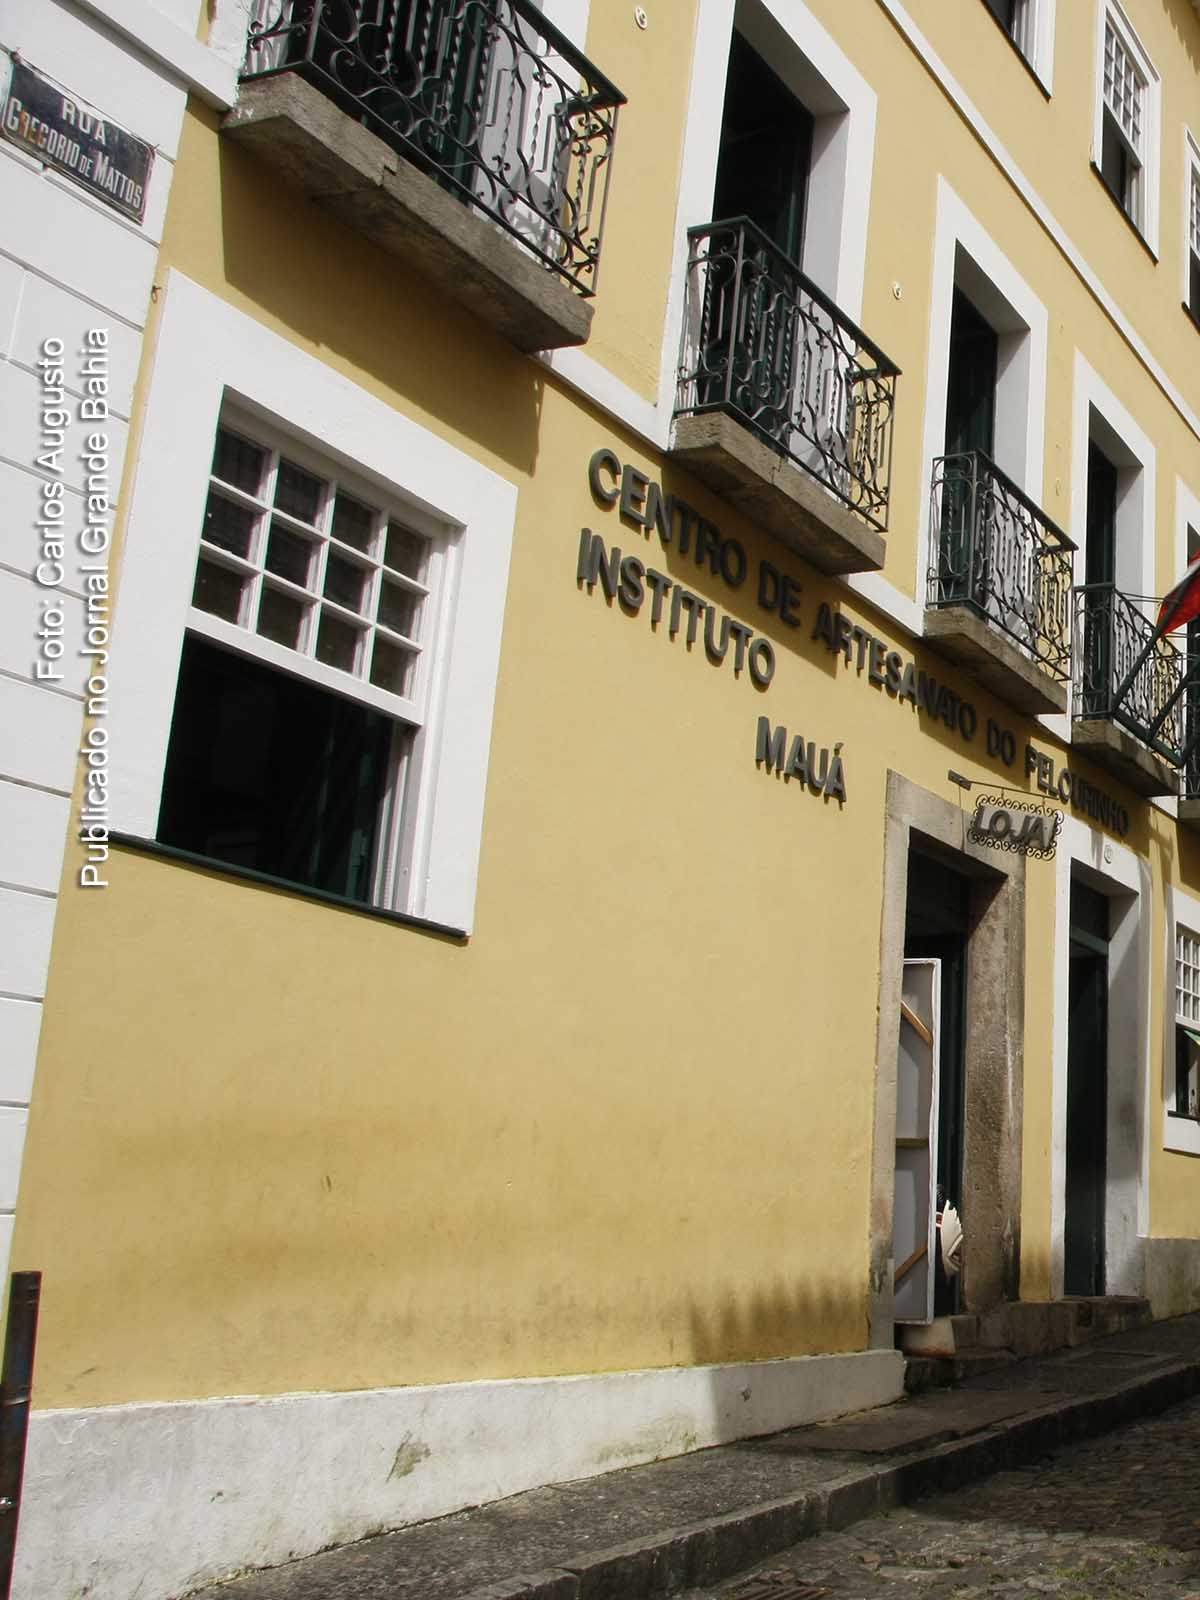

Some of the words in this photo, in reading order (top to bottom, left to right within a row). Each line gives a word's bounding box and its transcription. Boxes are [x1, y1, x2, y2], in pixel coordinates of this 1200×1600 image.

[7, 97, 80, 169] GREGORIO
[78, 154, 94, 179] DE
[94, 151, 143, 209] MATTOS
[61, 97, 106, 146] RUA
[577, 527, 776, 686] INSTITUTO
[588, 448, 748, 588] CENTRO
[758, 560, 803, 627] DE
[811, 601, 978, 741] ARTESANATO
[987, 718, 1018, 767] DO
[755, 715, 847, 803] MAUÁ
[972, 805, 1045, 849] LOJA
